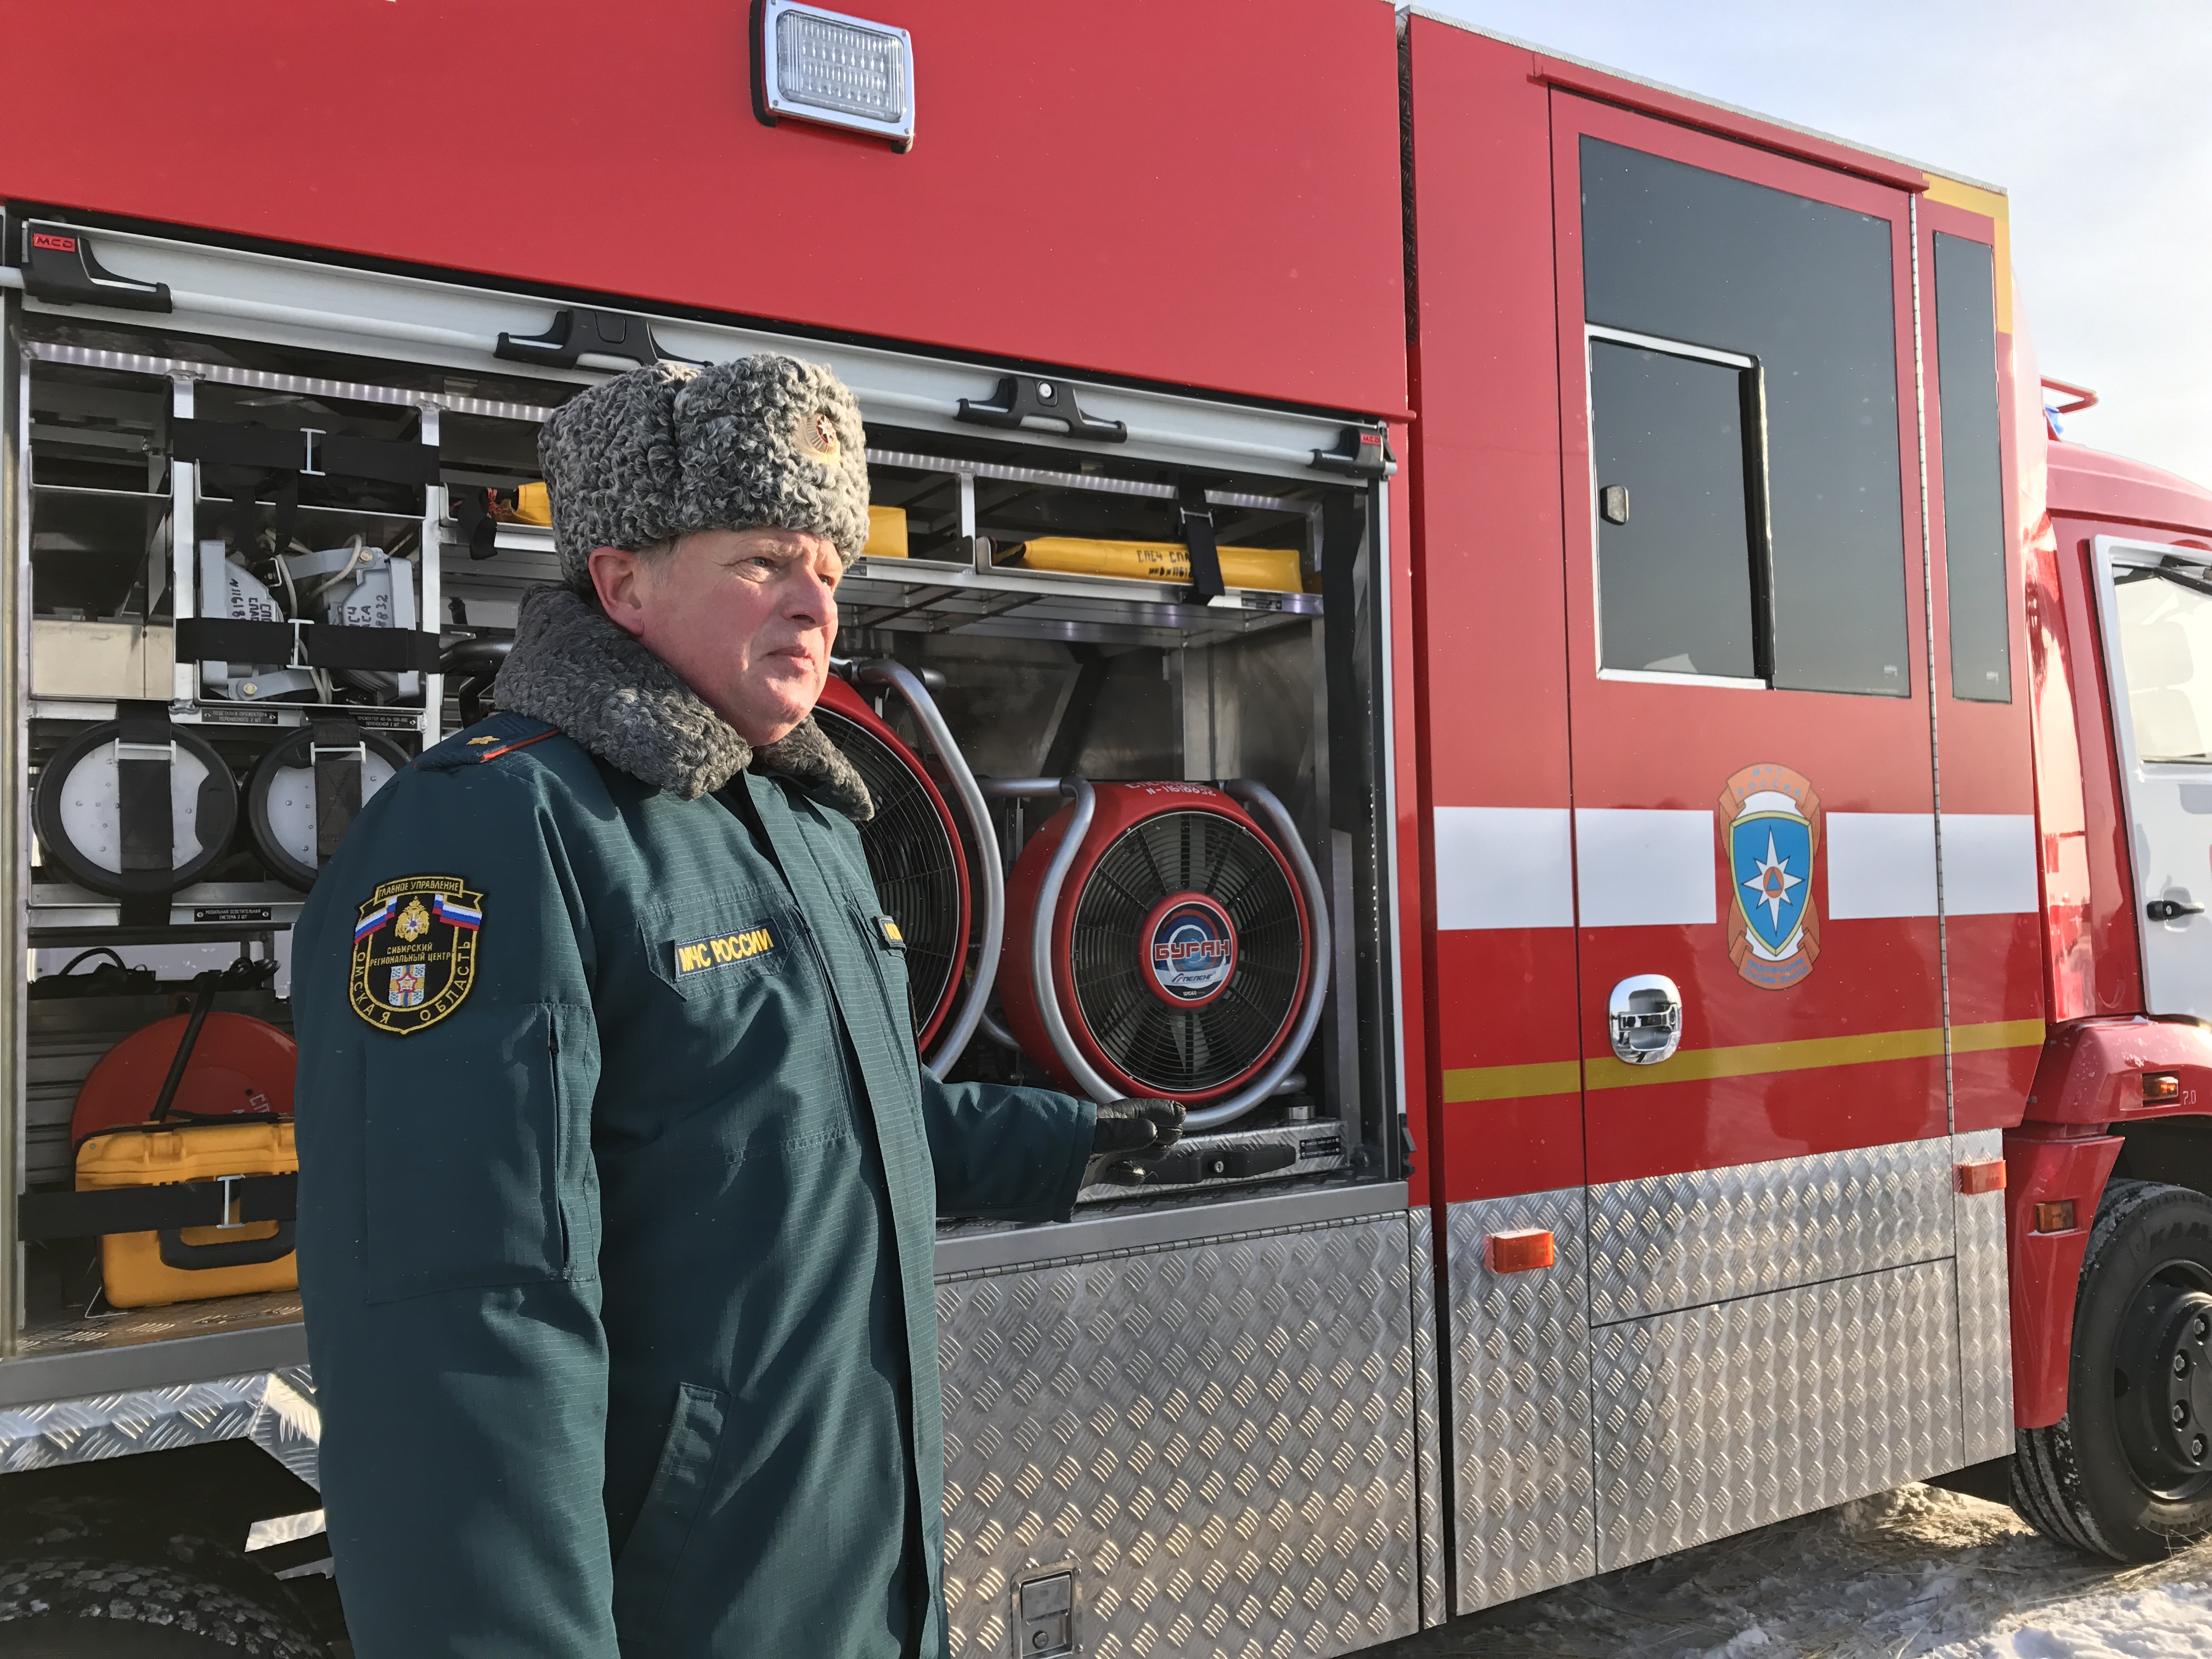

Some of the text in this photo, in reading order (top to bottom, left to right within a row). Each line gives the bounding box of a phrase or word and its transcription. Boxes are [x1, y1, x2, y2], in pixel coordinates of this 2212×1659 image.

[1752, 766, 1782, 778] МЧС
[1737, 778, 1802, 798] РОССИИ
[378, 879, 459, 898] ГЛАВНОЕ УПРАВЛЕНИЕ
[387, 941, 433, 955] СИБИРСКИЙ
[678, 928, 775, 972] МЧС РОССИИ
[1155, 939, 1230, 961] БУРАН
[369, 951, 452, 967] РЕГИОНАЛЬНЫЙ ЦЕНТР
[354, 941, 471, 1024] ОМСКАЯ ОБЛАСТЬ
[2183, 1090, 2197, 1105] 7.0
